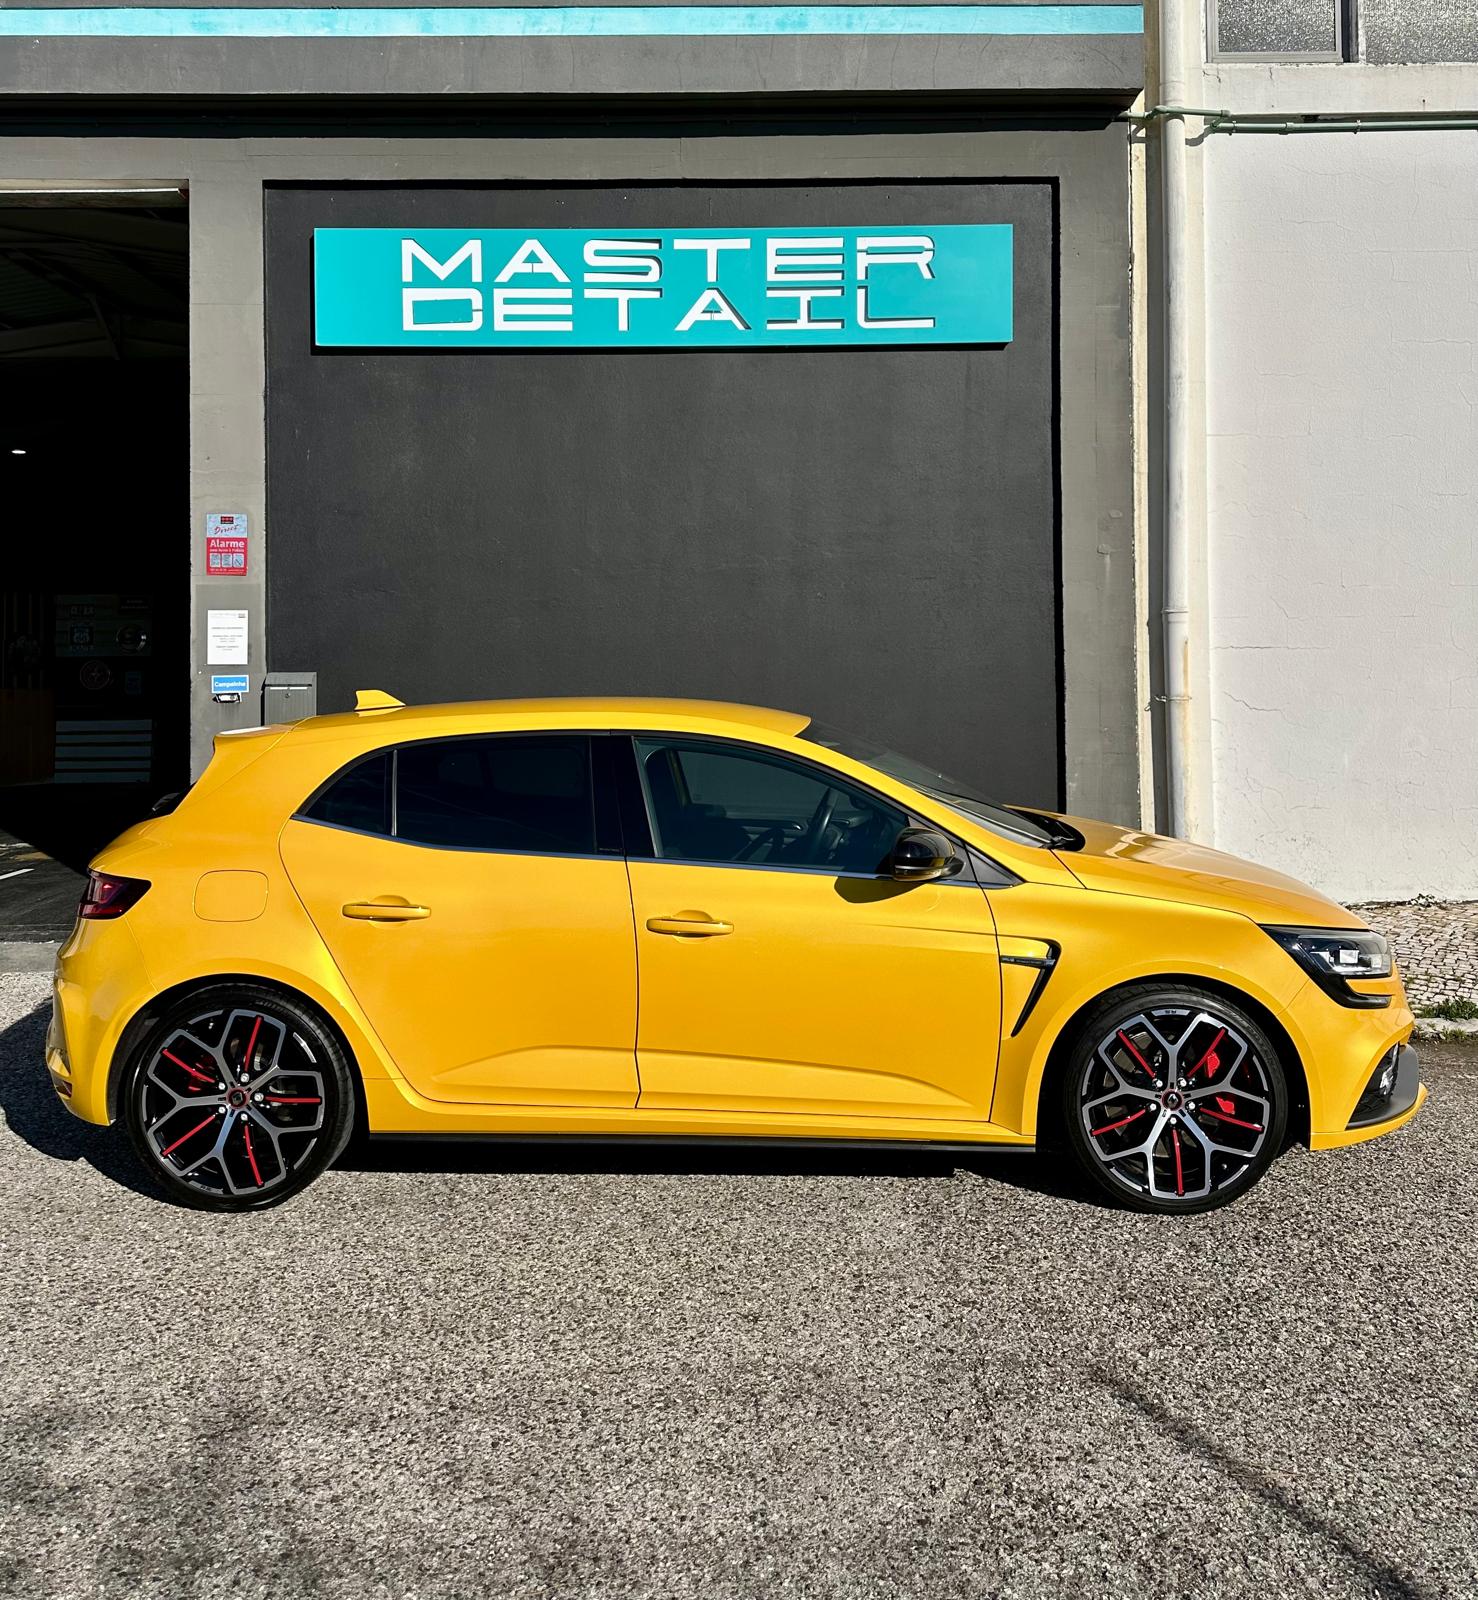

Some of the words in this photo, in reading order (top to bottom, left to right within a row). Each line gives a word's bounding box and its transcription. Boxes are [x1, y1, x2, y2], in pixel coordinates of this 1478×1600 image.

[401, 236, 934, 282] MASTER
[402, 287, 934, 331] DETAIL
[210, 538, 245, 548] Alarme
